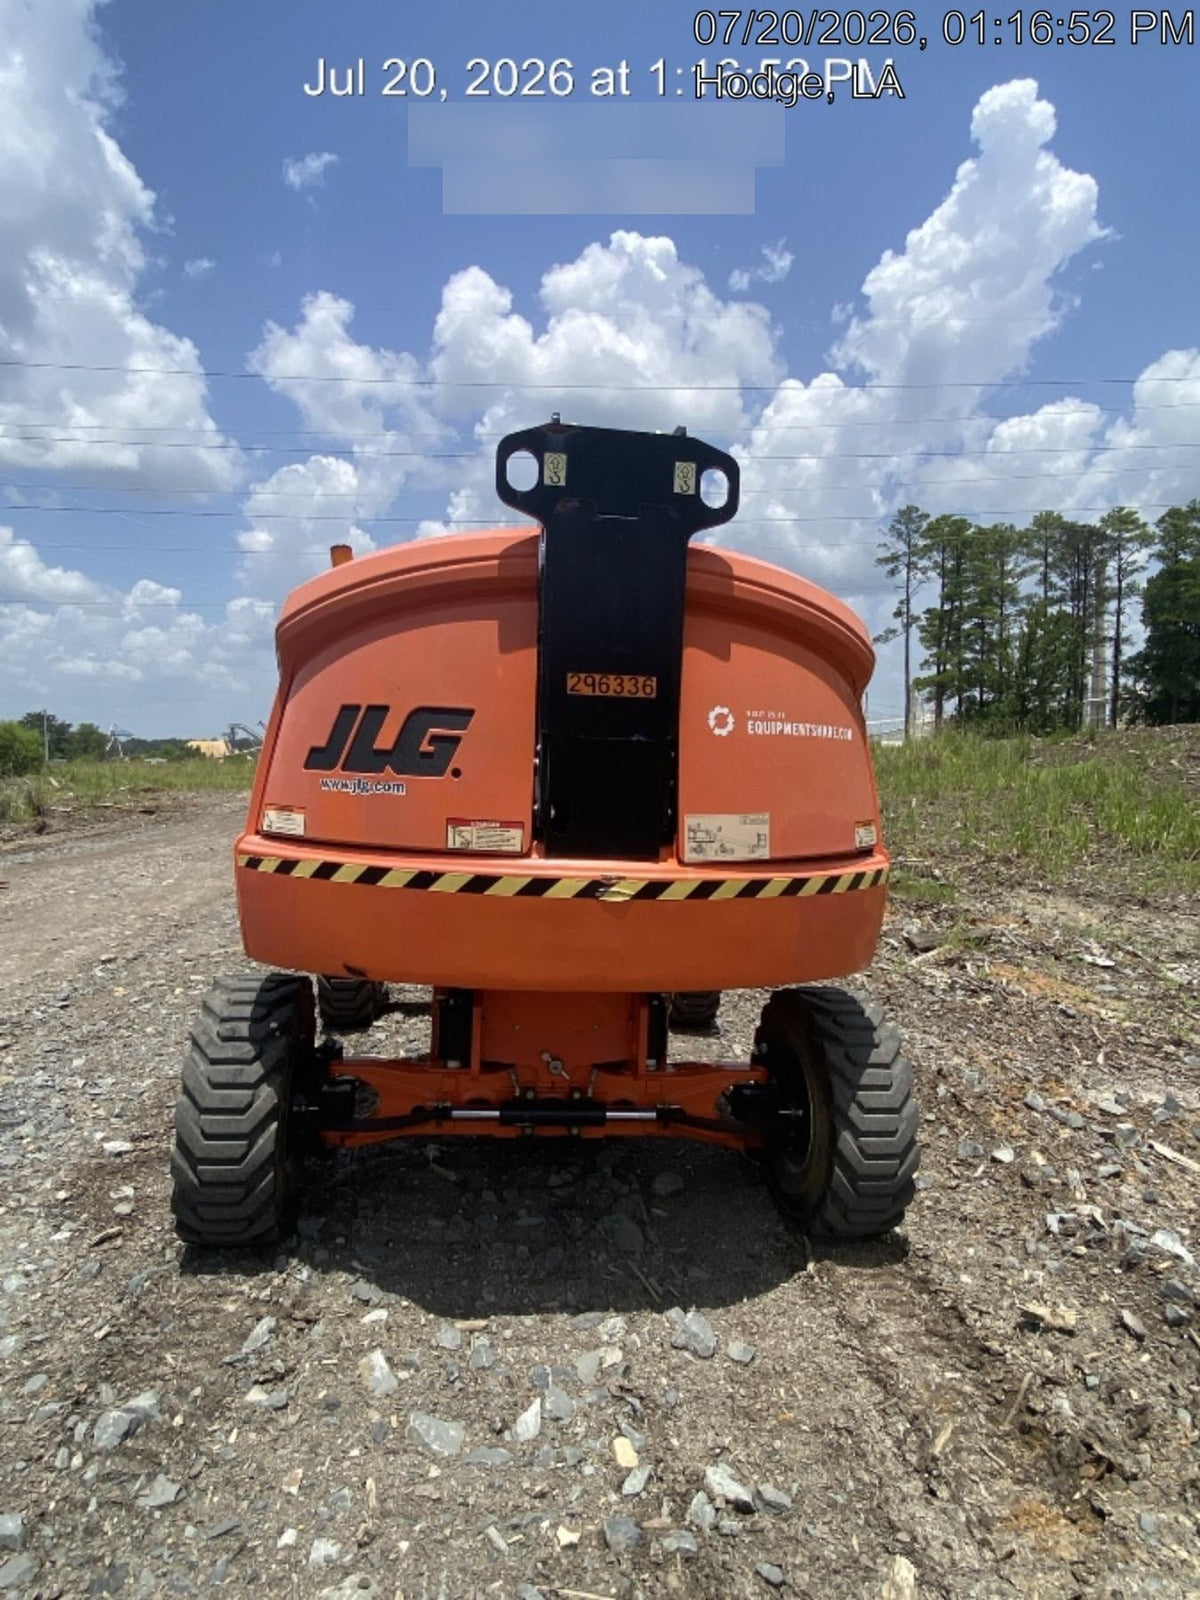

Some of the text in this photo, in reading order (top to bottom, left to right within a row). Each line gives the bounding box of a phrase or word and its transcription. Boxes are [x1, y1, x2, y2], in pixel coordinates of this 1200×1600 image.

[568, 674, 655, 696] 296336
[303, 704, 475, 778] JLG
[320, 778, 406, 796] www.jlg.com
